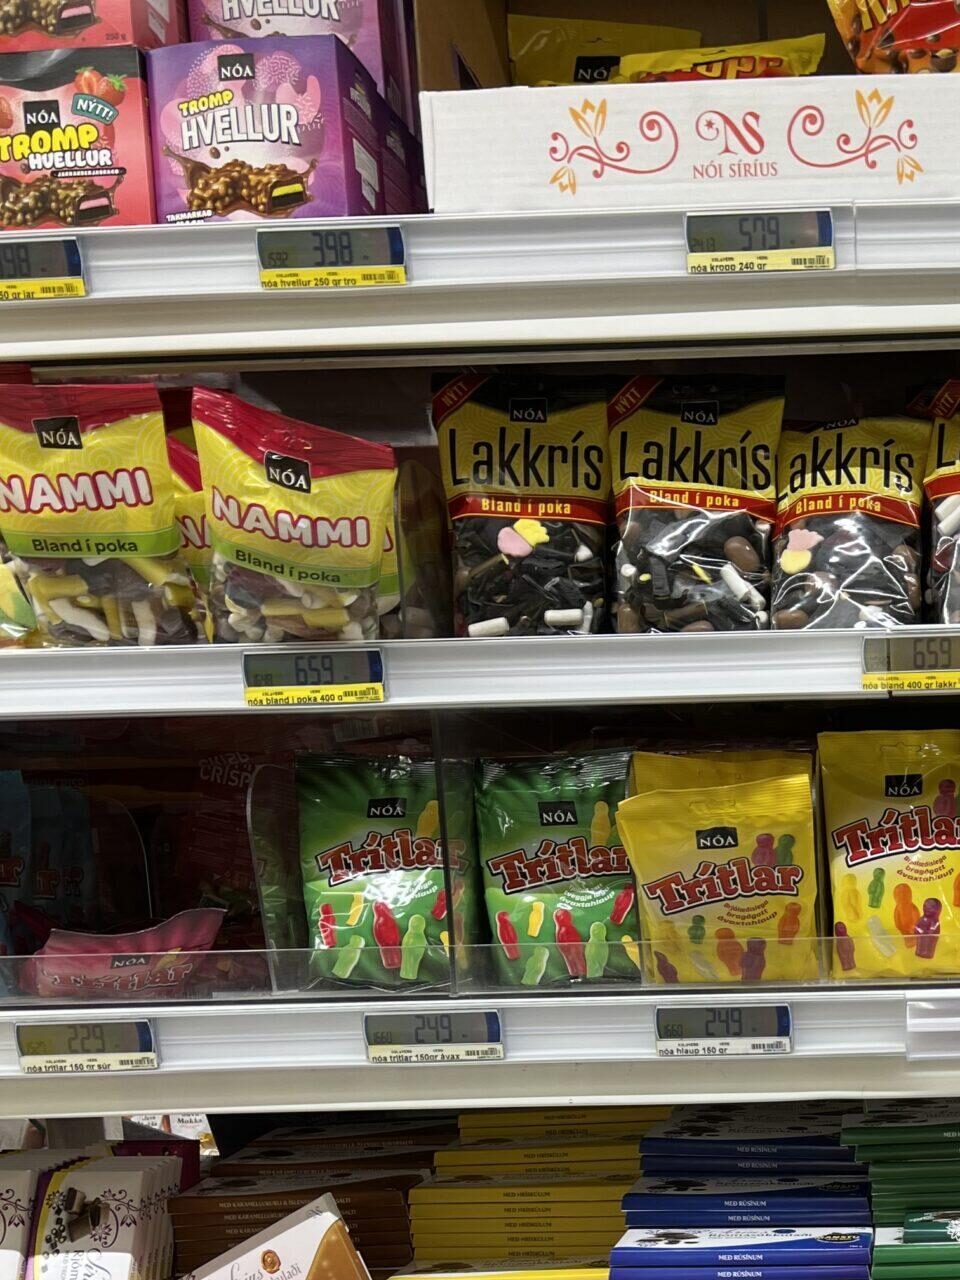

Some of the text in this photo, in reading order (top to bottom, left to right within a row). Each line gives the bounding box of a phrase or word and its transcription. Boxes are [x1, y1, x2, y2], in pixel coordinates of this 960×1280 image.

[220, 61, 254, 79] NÓA
[76, 97, 115, 120] NÝTT!
[178, 89, 234, 115] TROMP
[26, 108, 58, 126] NÓA
[181, 104, 302, 150] HVELLUR
[692, 160, 778, 181] NÓI SÍRÍUS
[311, 231, 352, 266] 398
[691, 263, 707, 272] nóa
[739, 262, 755, 270] 240
[280, 277, 312, 287] hvellur
[314, 278, 330, 286] 250
[513, 404, 546, 422] NÓA
[683, 407, 717, 424] NÓA
[41, 425, 81, 448] NÓA
[449, 427, 605, 491] Lakkrís
[619, 414, 771, 491] Lakkrís
[267, 464, 309, 491] NÓA
[481, 496, 520, 514] Bland
[539, 501, 572, 517] poka
[649, 489, 689, 507] Bland
[706, 494, 740, 510] poka
[796, 495, 834, 515] Bland
[849, 495, 882, 513] poka
[211, 486, 372, 548] NAMMI
[32, 538, 80, 553] Bland
[96, 540, 138, 557] poka
[234, 548, 281, 572] Bland
[299, 568, 341, 585] poka
[913, 639, 951, 669] 659
[878, 680, 904, 689] bland
[907, 681, 922, 689] 400
[320, 694, 335, 702] 400
[887, 782, 920, 798] NÓA
[370, 804, 403, 817] NÓA
[542, 808, 576, 825] NÓA
[700, 831, 736, 848] NÓA
[488, 833, 631, 894] Trítlar
[643, 860, 804, 915] Trítlar
[414, 1014, 451, 1043] 249
[706, 1008, 742, 1036] 249
[717, 1252, 764, 1262] MEÐ RÚSÍNUM
[717, 1269, 763, 1279] MEÐ RÚSÍNUM
